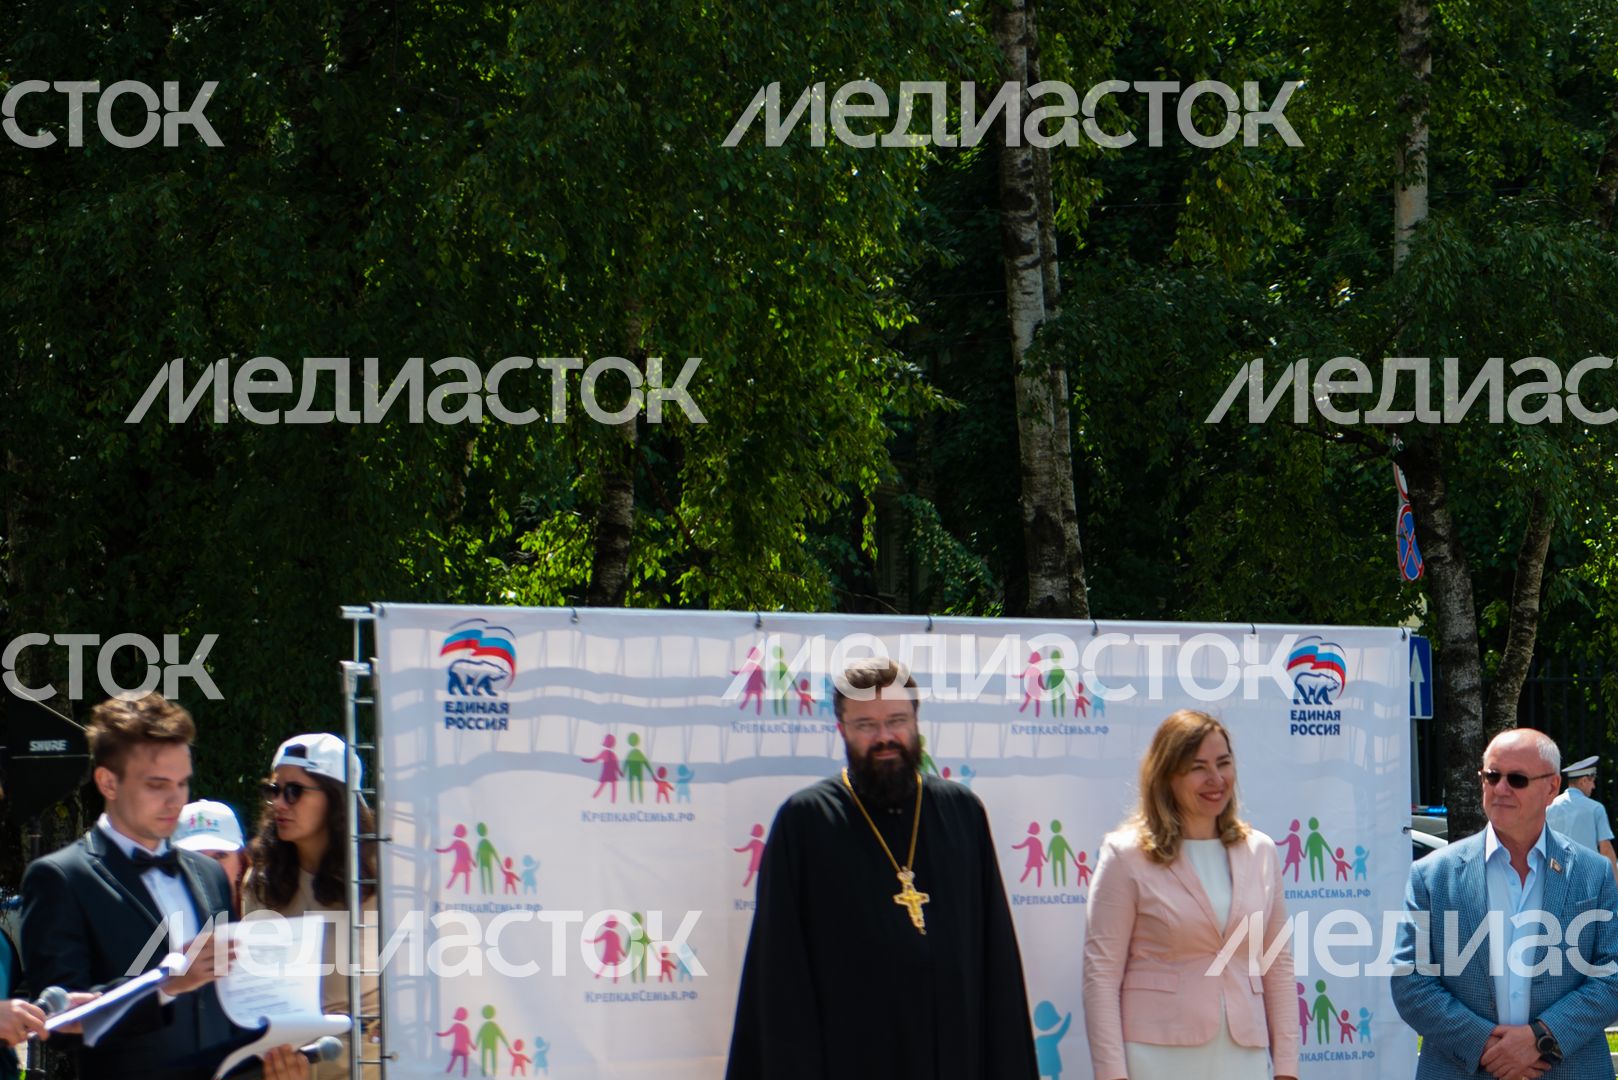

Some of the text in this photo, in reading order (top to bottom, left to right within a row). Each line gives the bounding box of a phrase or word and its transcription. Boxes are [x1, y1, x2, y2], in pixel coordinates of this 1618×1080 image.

[444, 701, 509, 714] ЕДИНАЯ
[1290, 710, 1341, 722] ЕДИНАЯ
[444, 716, 508, 730] РОССИЯ
[1290, 723, 1341, 735] РОССИЯ
[30, 740, 67, 752] SHURE
